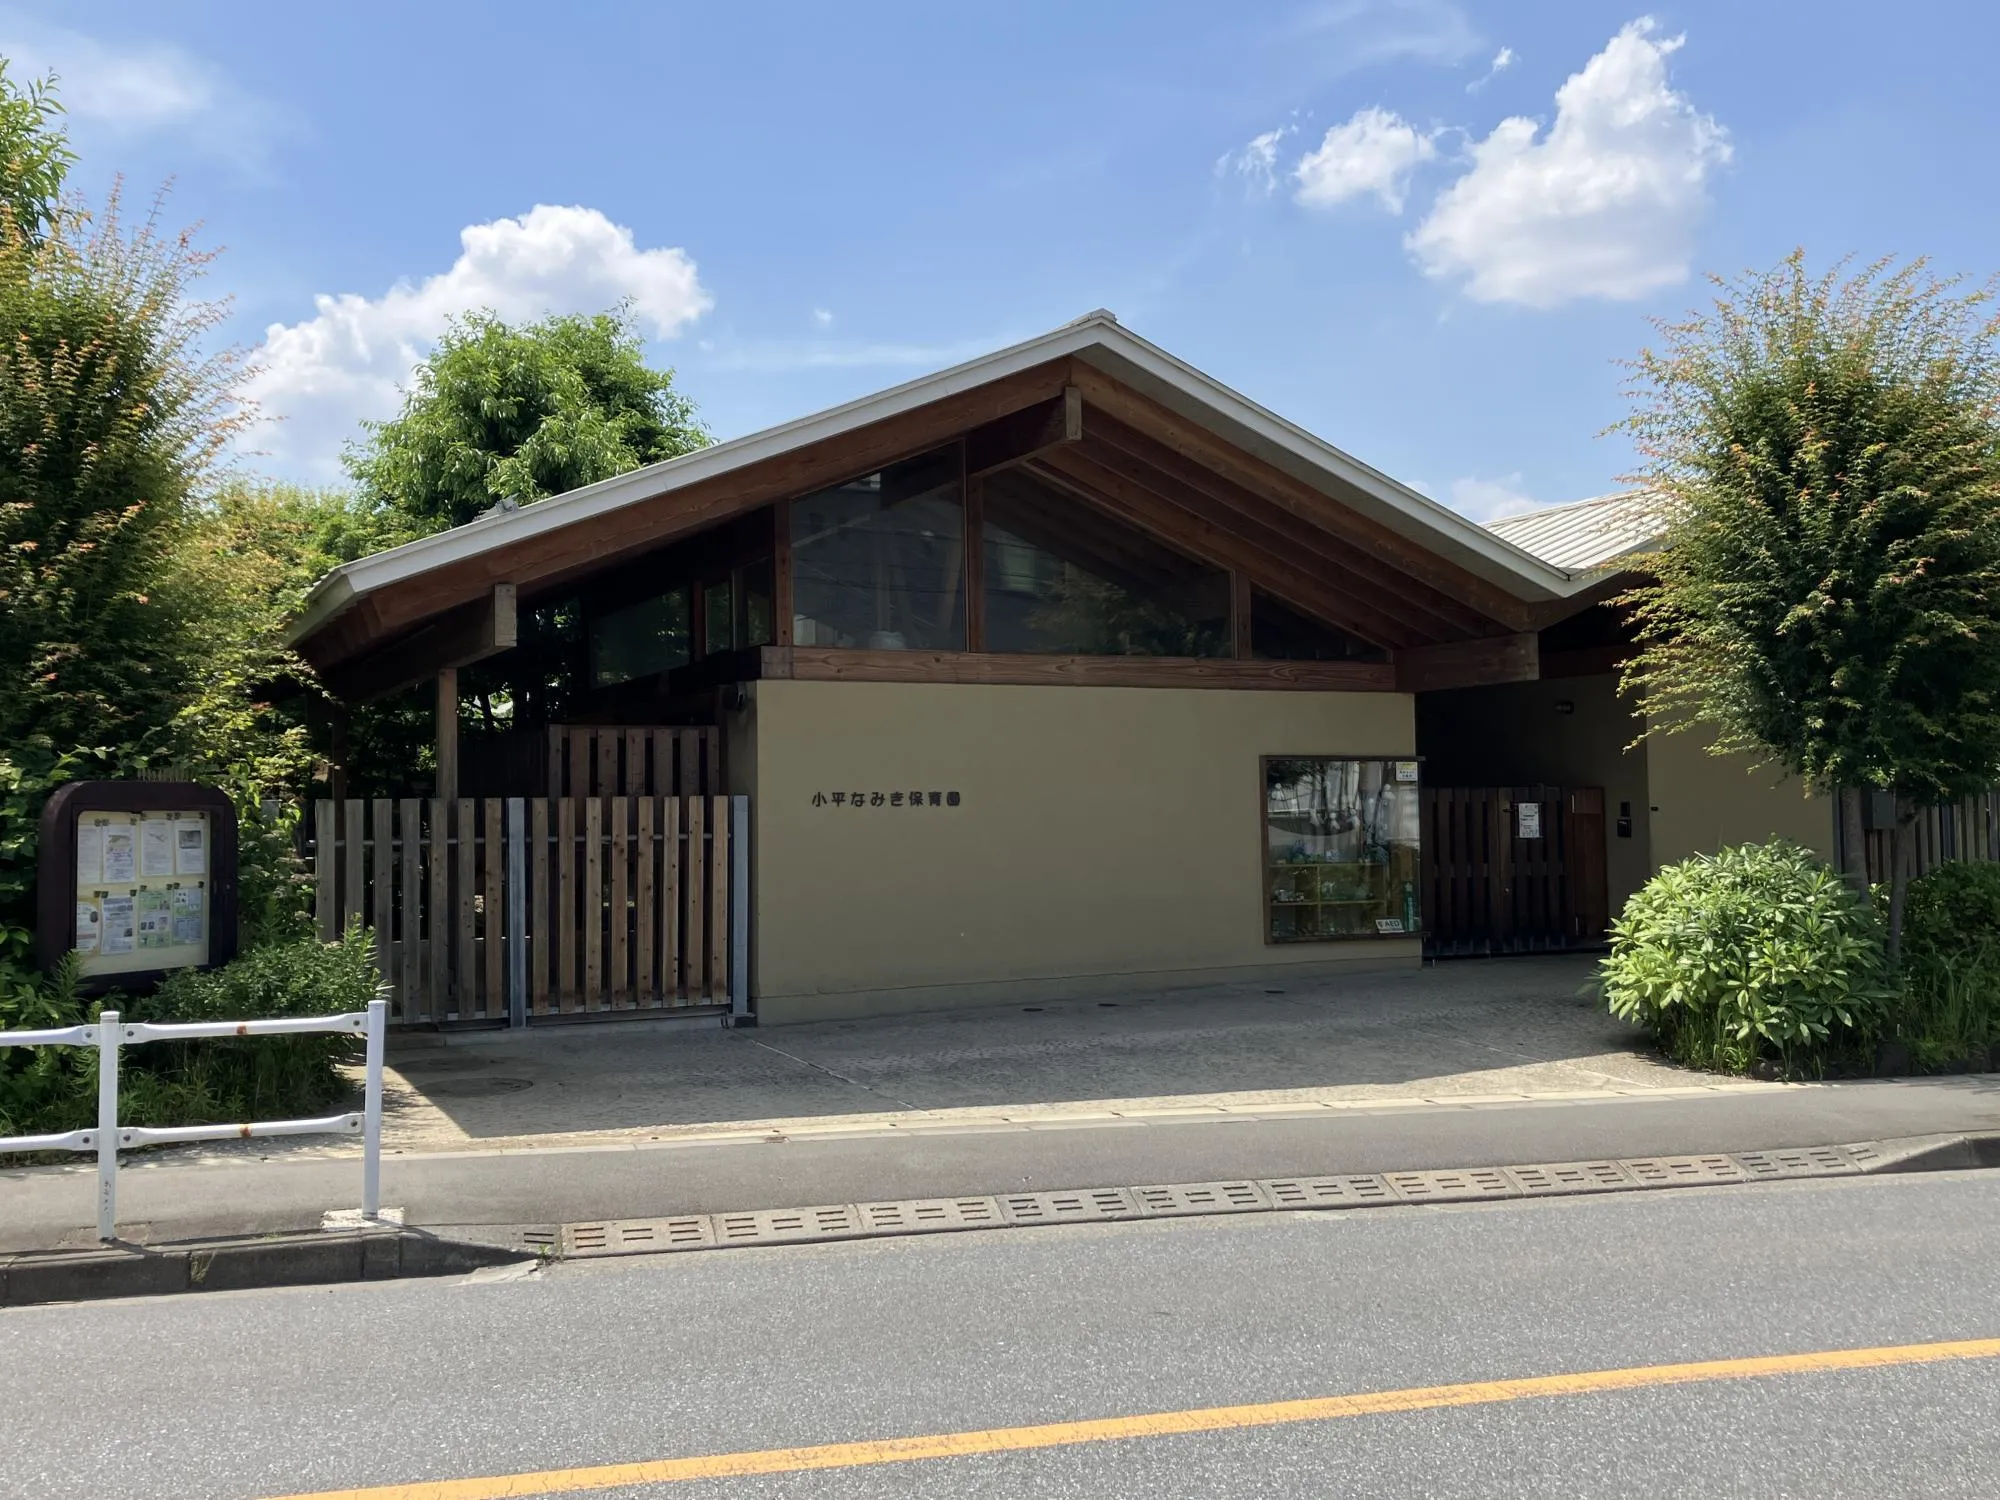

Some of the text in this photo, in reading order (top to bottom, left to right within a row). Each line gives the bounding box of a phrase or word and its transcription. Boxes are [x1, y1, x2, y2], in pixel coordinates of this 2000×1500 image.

[812, 791, 961, 807] 小平なみき保育園
[1385, 920, 1400, 928] AED
